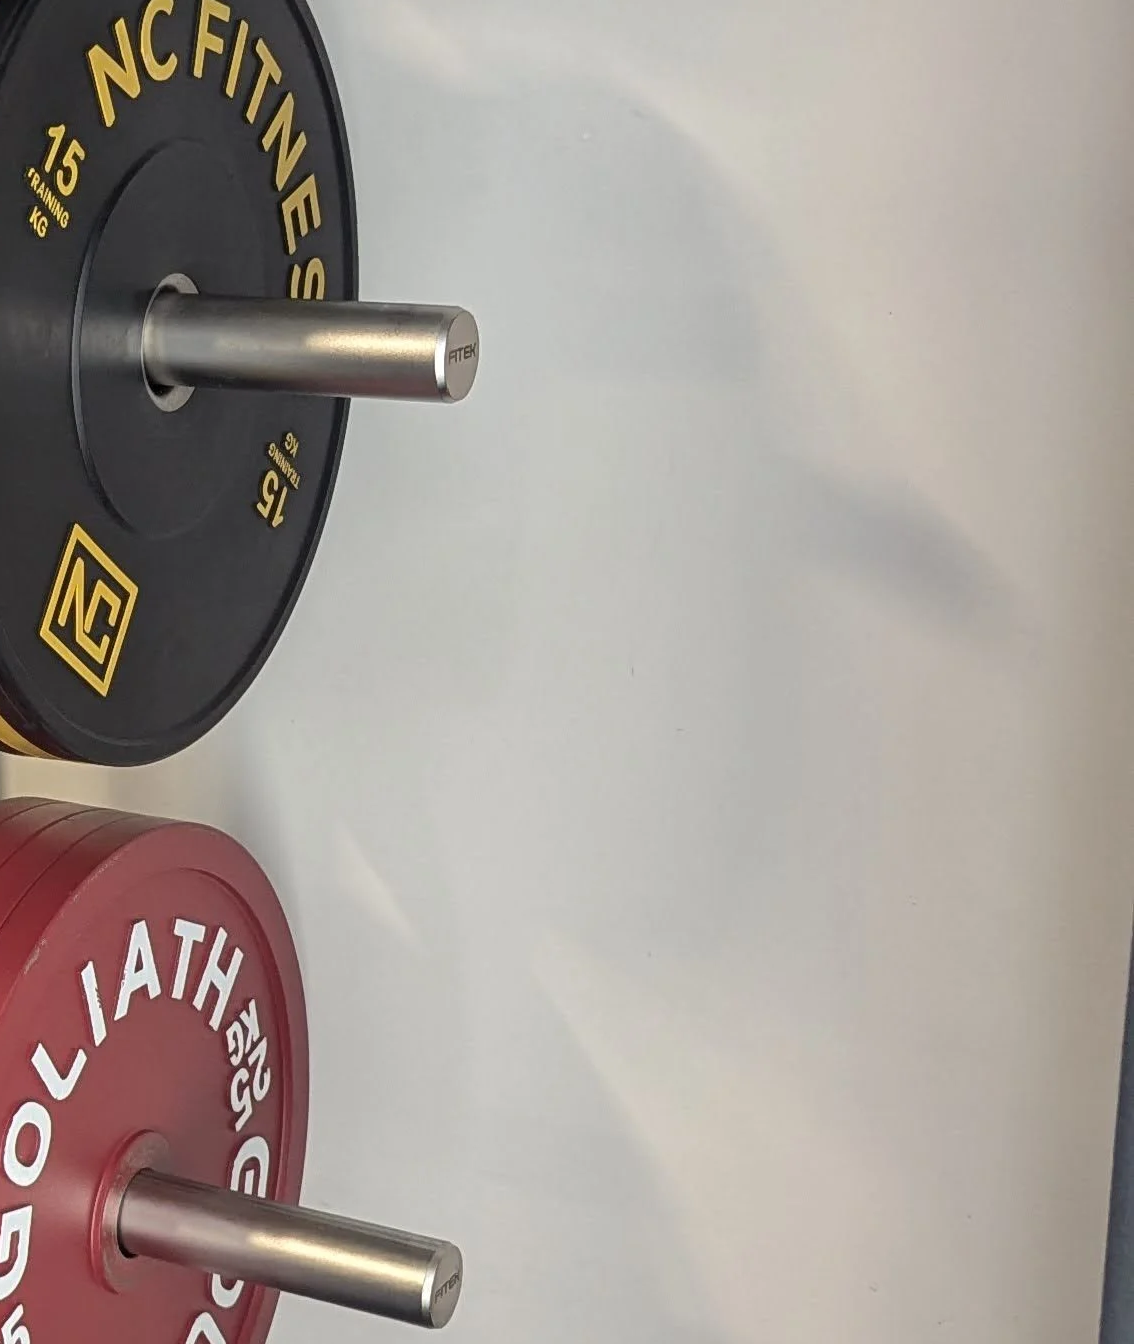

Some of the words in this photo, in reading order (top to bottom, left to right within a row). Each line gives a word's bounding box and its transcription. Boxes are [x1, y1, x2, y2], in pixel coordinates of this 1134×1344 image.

[45, 124, 85, 196] 15
[28, 167, 69, 229] TRAINING
[29, 205, 48, 238] KG
[448, 341, 477, 366] FITEK
[268, 442, 300, 489] TRAINING
[285, 432, 299, 457] KG
[257, 470, 287, 528] 15
[226, 999, 260, 1066] KG
[230, 1037, 271, 1132] 25
